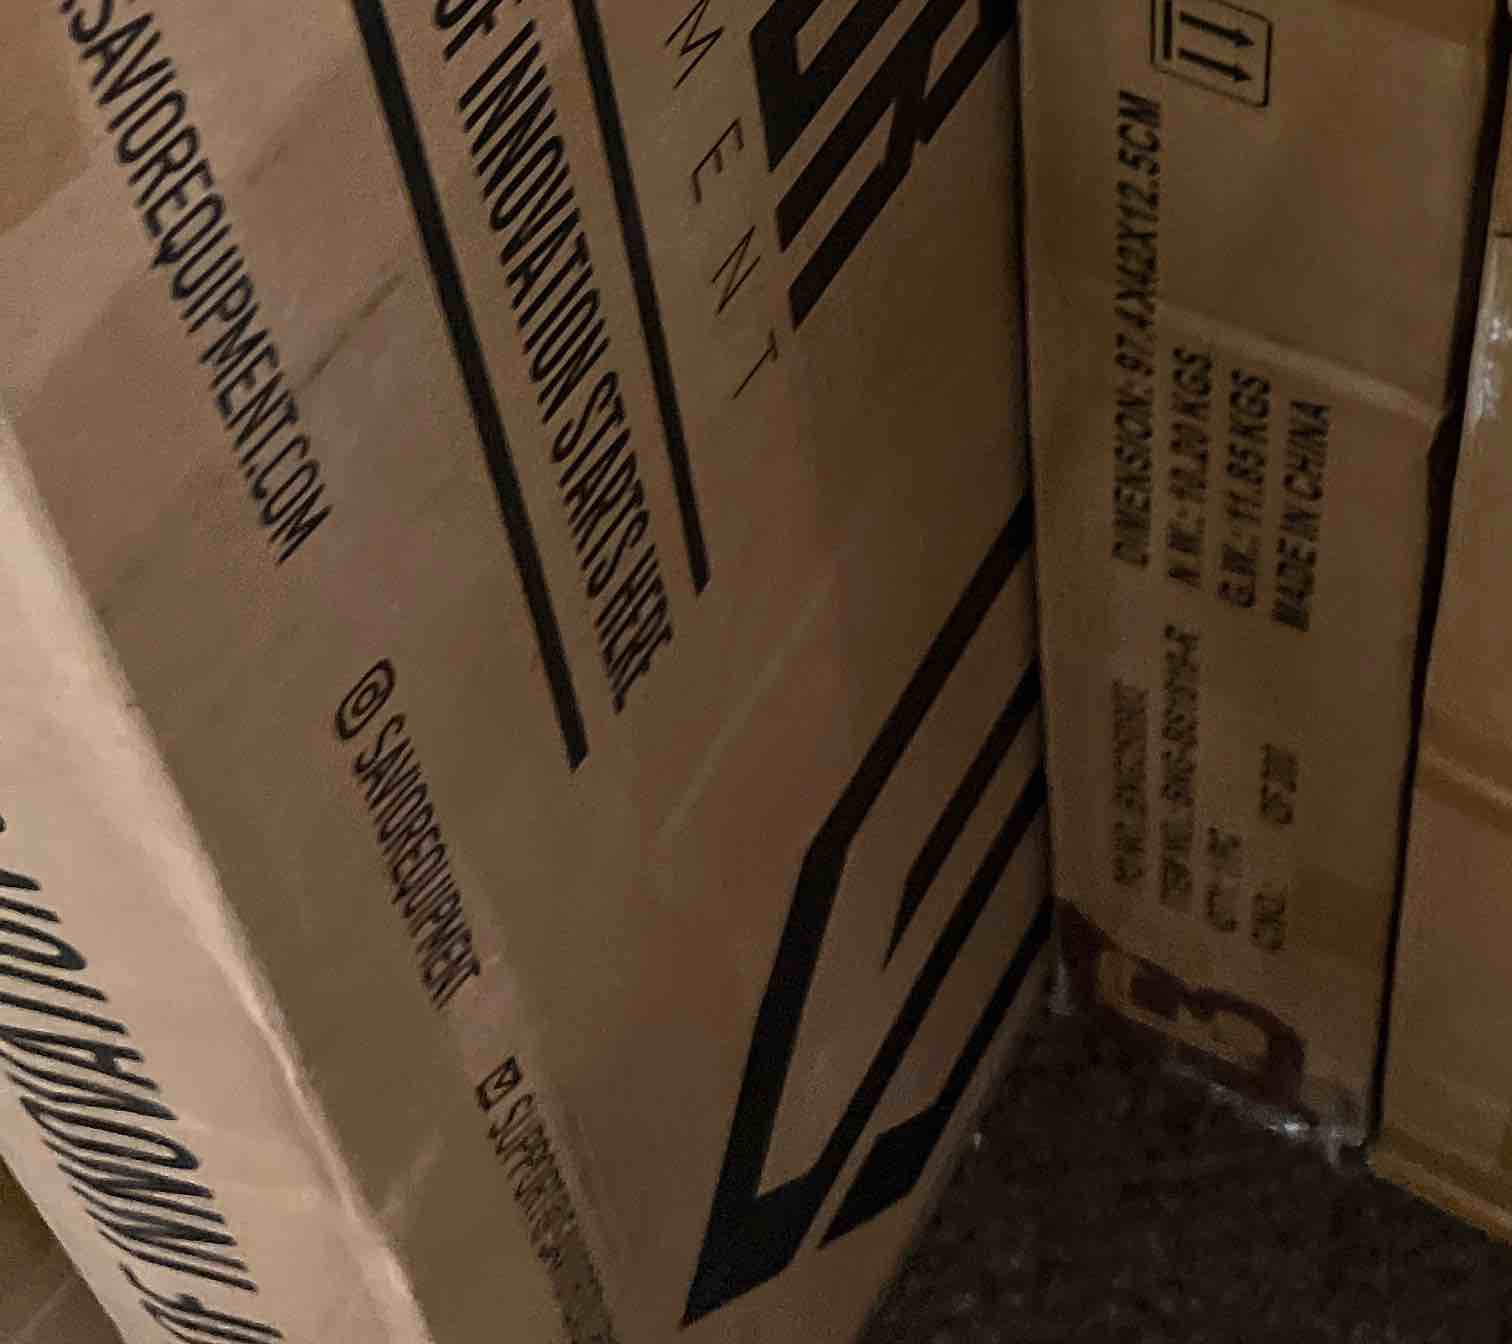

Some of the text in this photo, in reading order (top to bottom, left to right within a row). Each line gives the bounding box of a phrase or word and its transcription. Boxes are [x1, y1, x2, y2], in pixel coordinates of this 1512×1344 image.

[457, 18, 615, 426] INNOVATION
[551, 370, 650, 597] STARTS
[596, 544, 673, 713] HERE
[354, 713, 482, 1013] SAVIOREQUIPMENT
